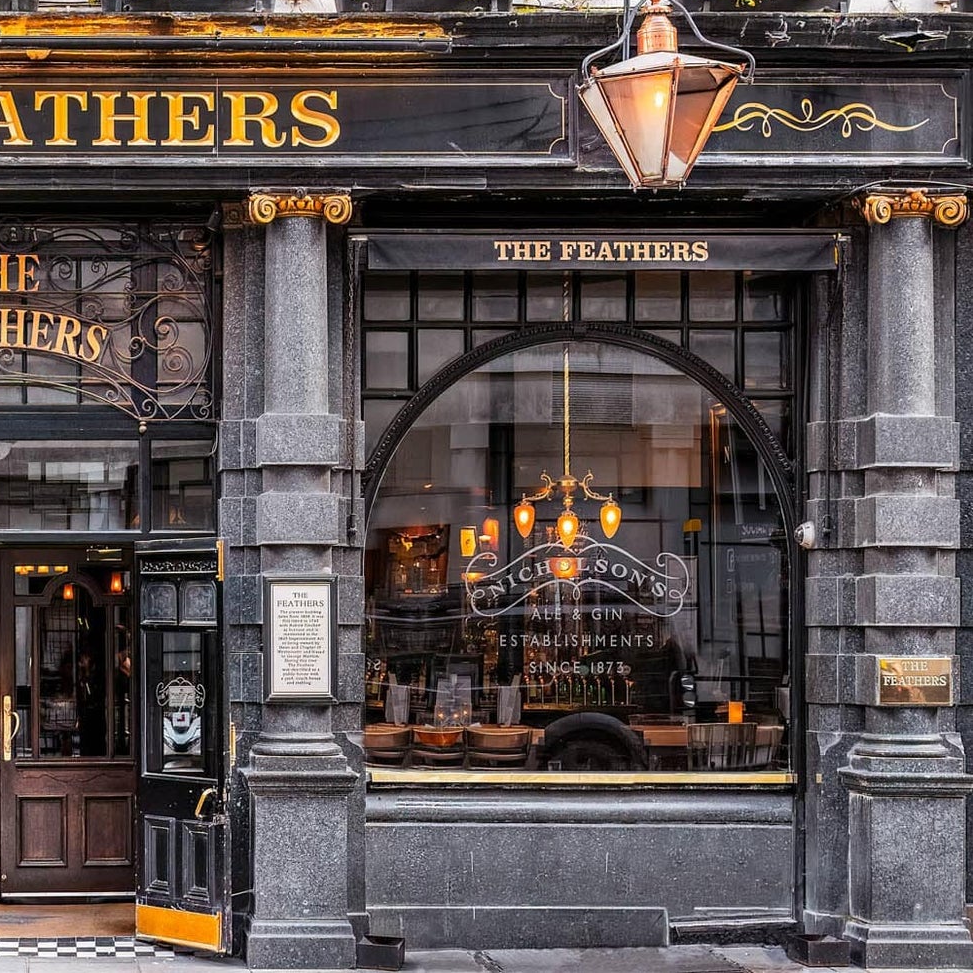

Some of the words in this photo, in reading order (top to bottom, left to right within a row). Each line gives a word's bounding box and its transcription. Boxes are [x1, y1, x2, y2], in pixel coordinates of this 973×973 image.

[494, 241, 551, 261] THE
[559, 241, 708, 262] FEATHERS
[487, 557, 667, 599] NICHOLSON'S
[531, 608, 562, 620] ALE
[572, 608, 581, 620] &
[591, 608, 622, 620] GIN
[499, 634, 654, 648] ESTABLISHMENTS
[529, 661, 580, 674] SINCE
[590, 661, 624, 674] 1873
[901, 661, 928, 671] THE
[883, 675, 947, 686] FEATHERS
